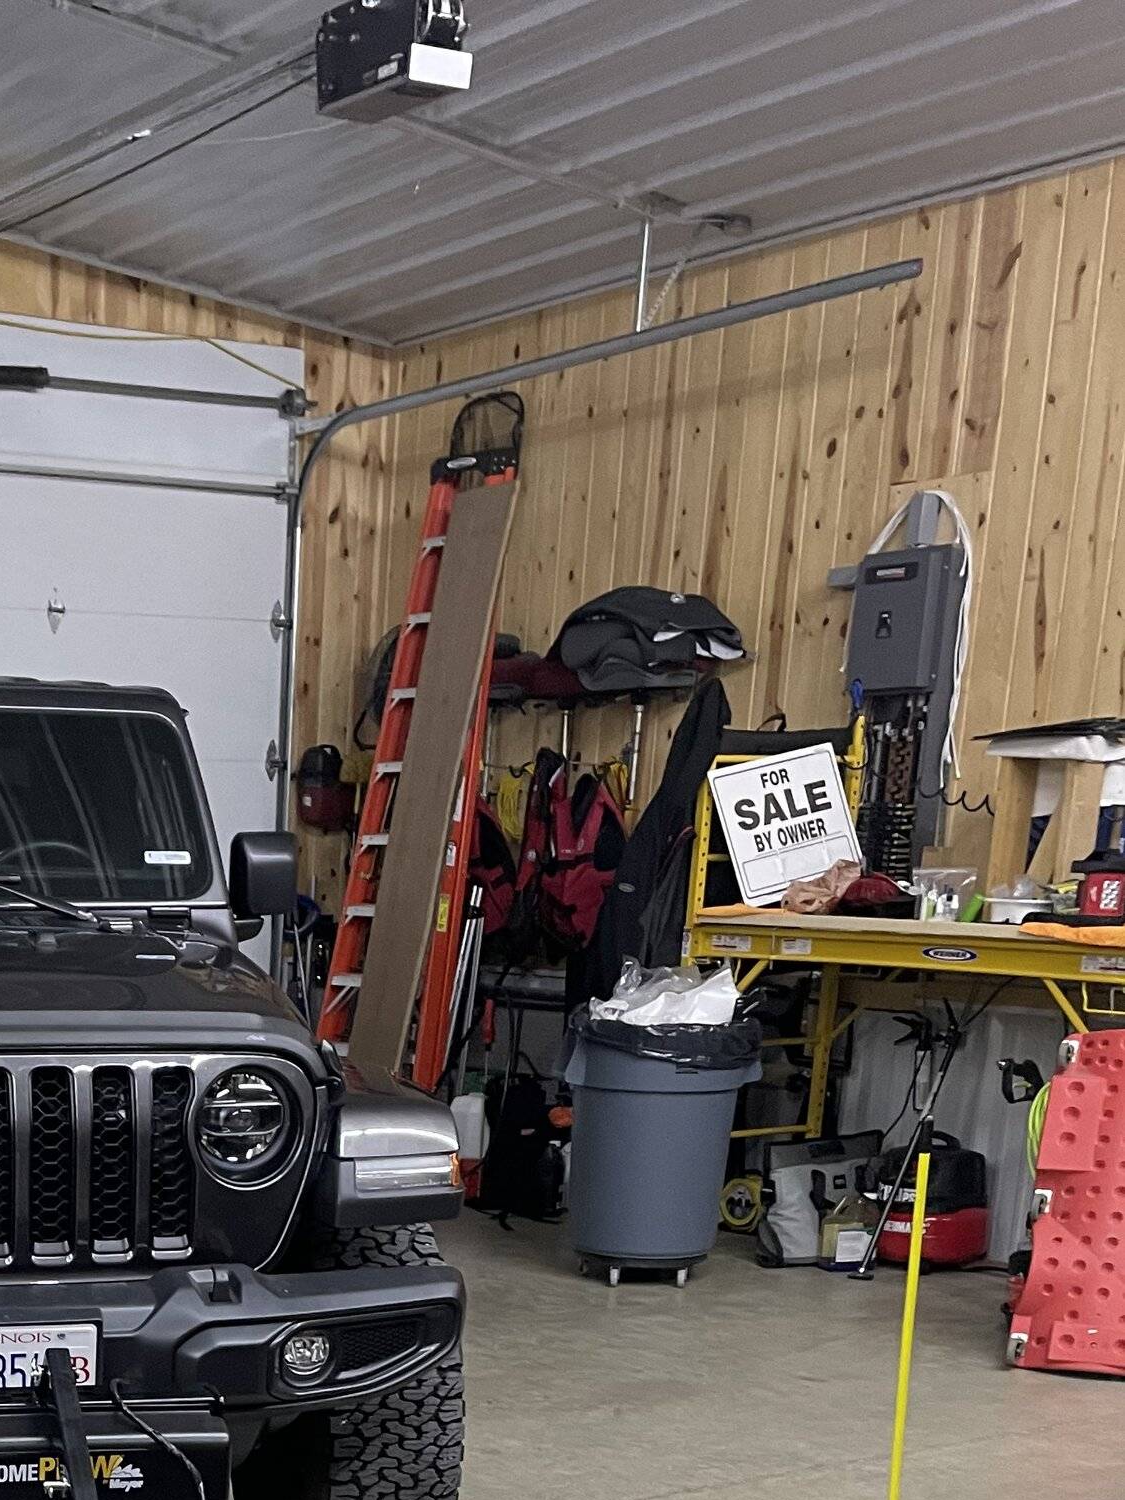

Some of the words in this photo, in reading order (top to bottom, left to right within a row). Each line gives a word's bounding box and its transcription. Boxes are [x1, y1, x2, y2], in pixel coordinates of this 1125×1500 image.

[760, 768, 790, 788] FOR
[734, 779, 832, 831] SALE
[754, 831, 773, 852] BY
[777, 818, 827, 847] OWNER
